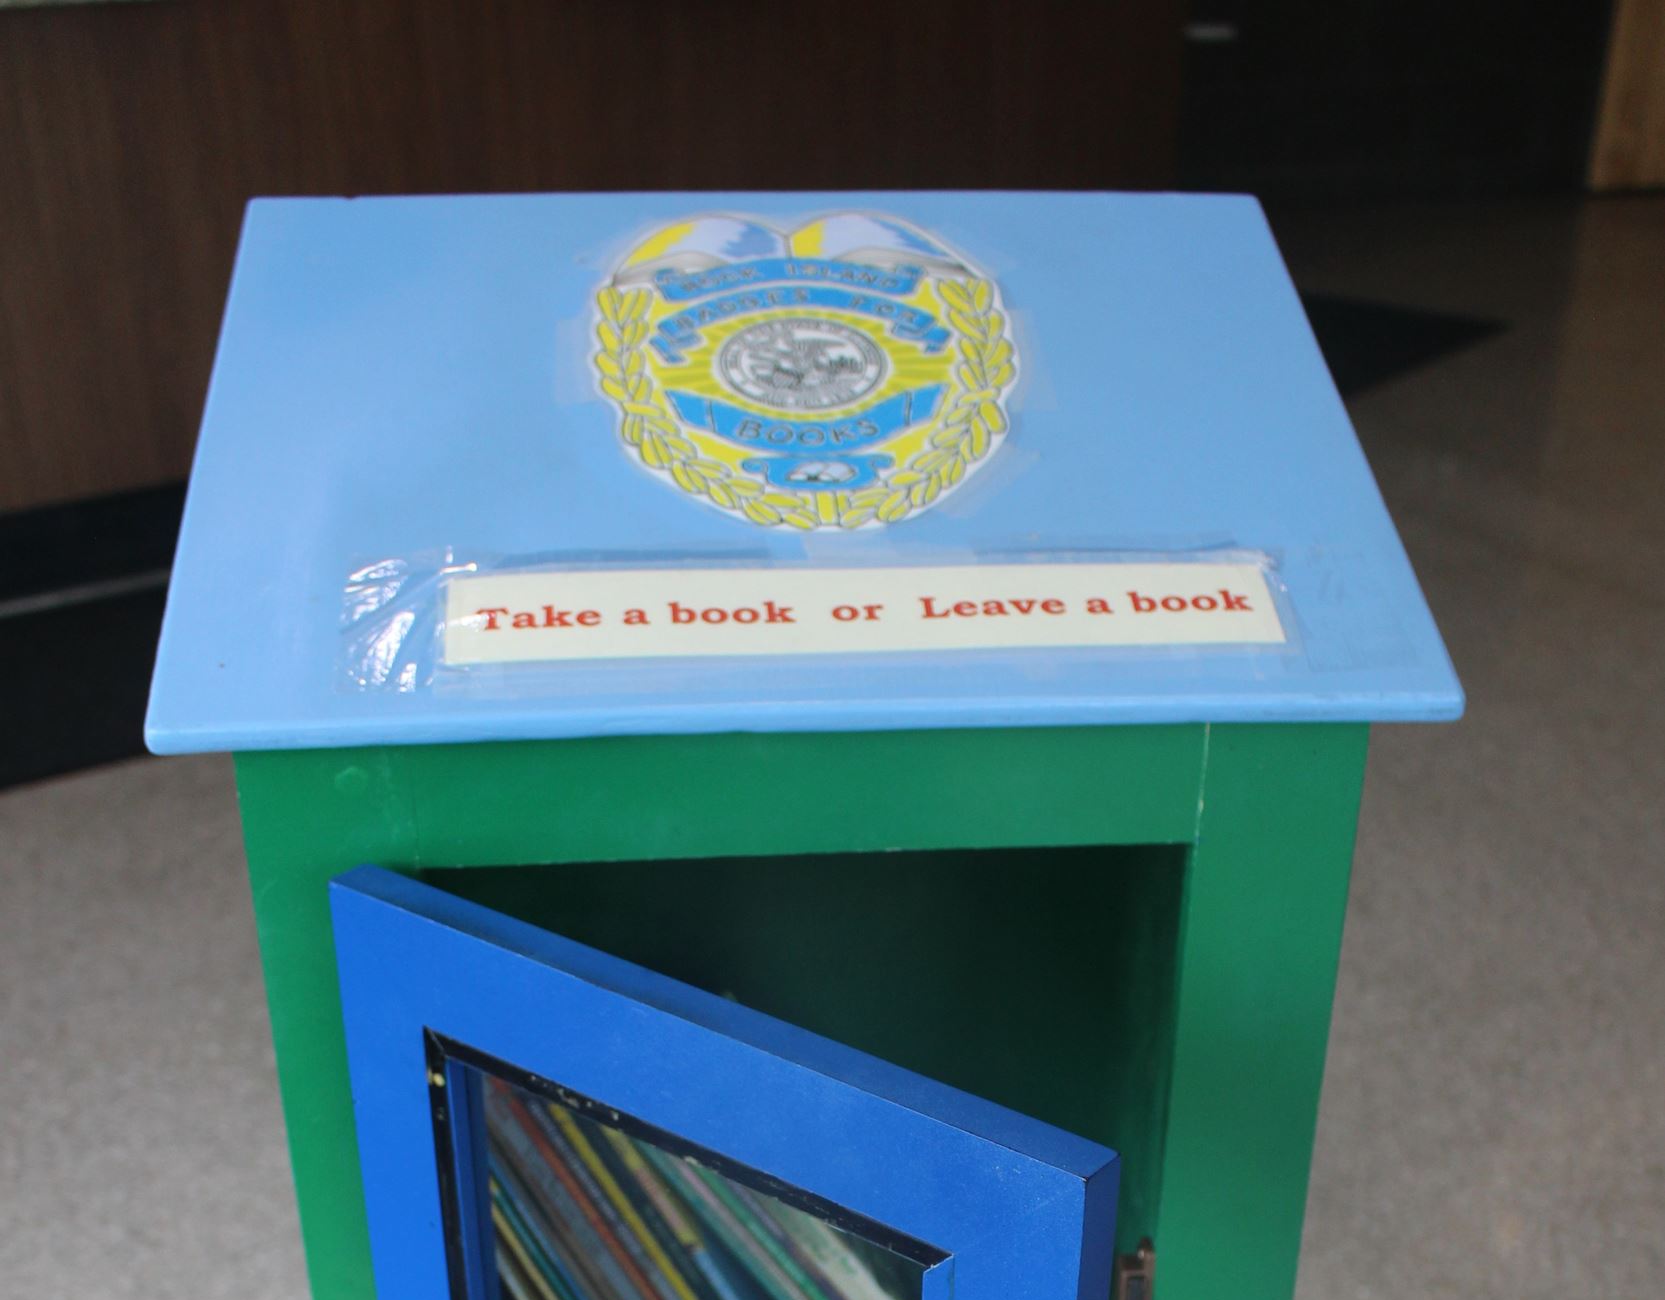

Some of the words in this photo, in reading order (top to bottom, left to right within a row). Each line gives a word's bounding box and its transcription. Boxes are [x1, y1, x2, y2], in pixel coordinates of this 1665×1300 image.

[736, 417, 879, 445] BOOKS
[477, 604, 601, 631] Take
[623, 607, 649, 626] a
[668, 599, 793, 626] book
[830, 603, 882, 622] or
[920, 595, 1064, 619] Leave
[1086, 598, 1112, 615] a
[1128, 588, 1249, 614] book
